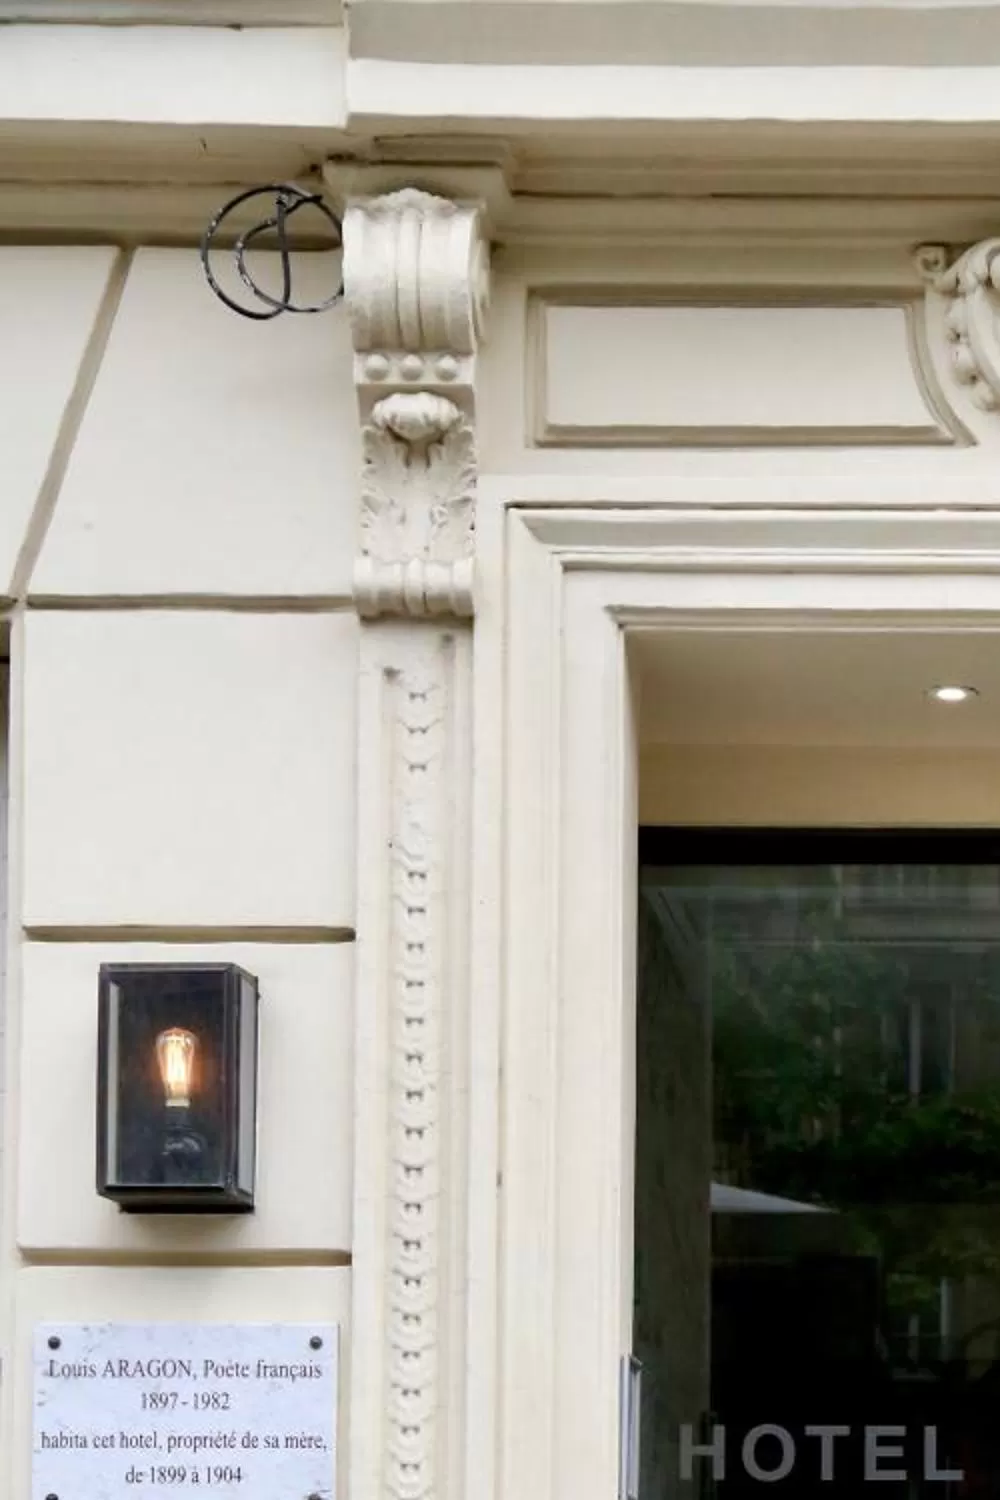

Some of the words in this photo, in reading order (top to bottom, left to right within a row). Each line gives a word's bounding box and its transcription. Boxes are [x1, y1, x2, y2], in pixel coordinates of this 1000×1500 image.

[48, 1359, 97, 1378] Louis
[102, 1359, 198, 1381] ARAGON,
[256, 1359, 323, 1383] français
[41, 1431, 88, 1449] habita
[93, 1434, 115, 1449] cet
[167, 1431, 237, 1453] propriété
[241, 1431, 259, 1449] de
[263, 1435, 280, 1449] sa
[284, 1431, 328, 1452] mère,
[679, 1423, 965, 1482] HOTEL
[125, 1466, 144, 1484] de
[149, 1466, 187, 1484] 1899
[191, 1466, 201, 1484] à
[206, 1466, 242, 1484] 1904
